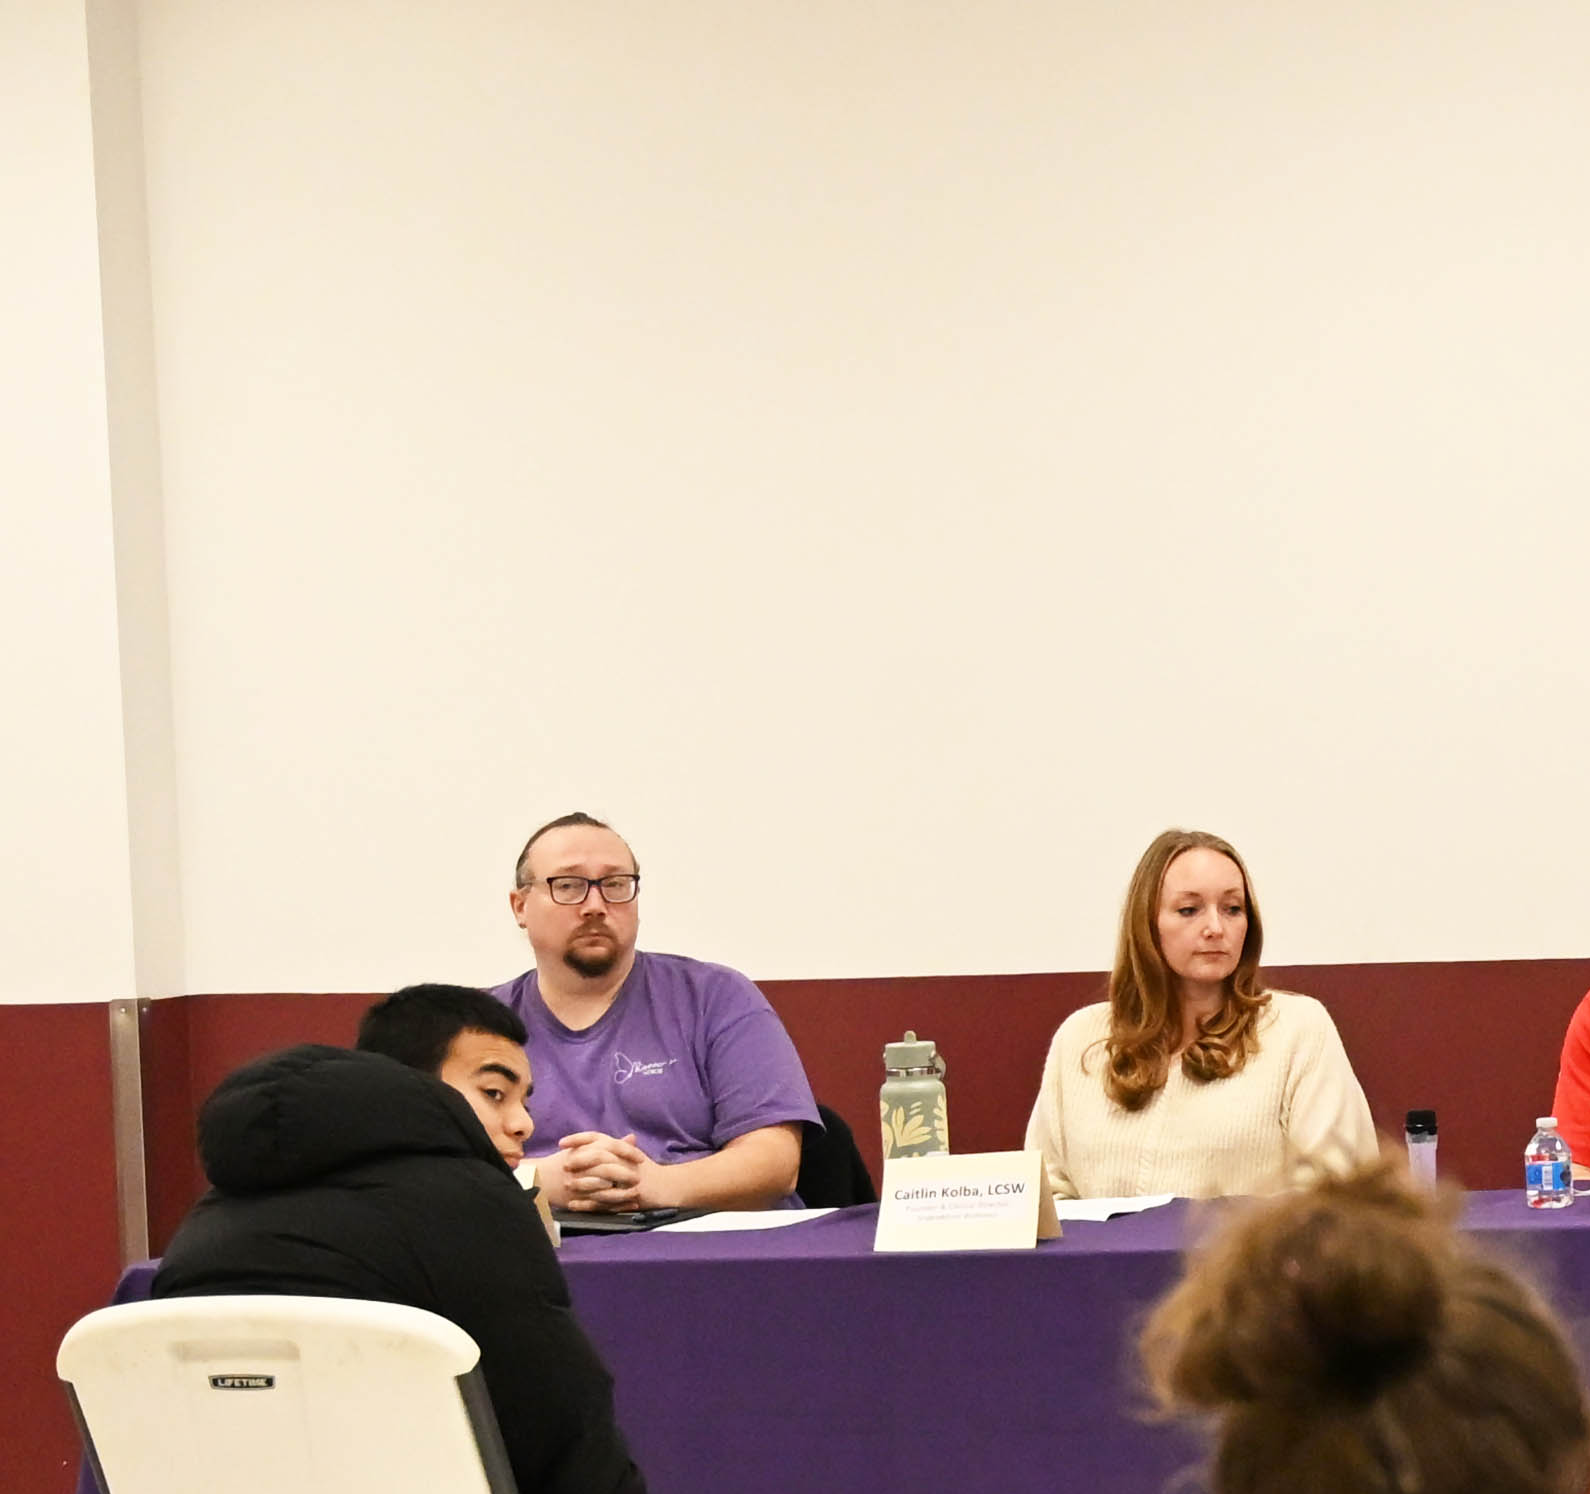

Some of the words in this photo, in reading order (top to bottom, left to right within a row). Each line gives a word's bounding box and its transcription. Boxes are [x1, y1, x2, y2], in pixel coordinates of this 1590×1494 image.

[894, 1186, 937, 1201] Caitlin
[941, 1185, 983, 1199] Kolba,
[988, 1183, 1025, 1196] LCSW
[217, 1378, 268, 1387] LIFETIME
